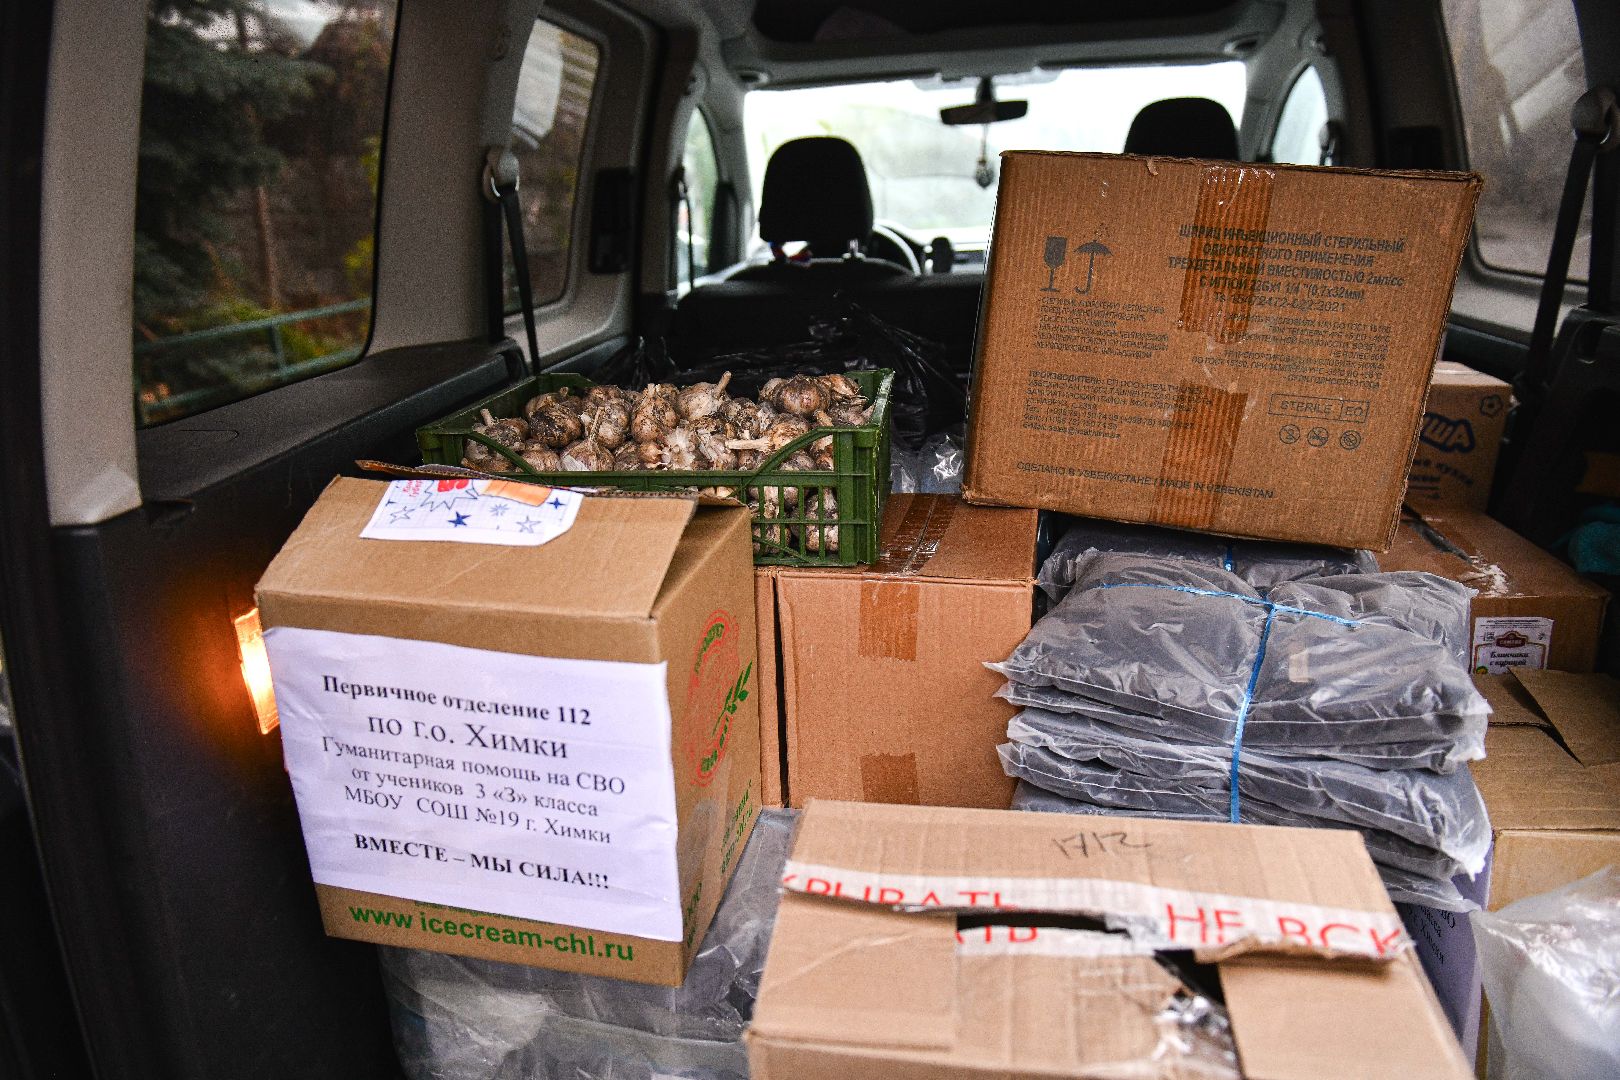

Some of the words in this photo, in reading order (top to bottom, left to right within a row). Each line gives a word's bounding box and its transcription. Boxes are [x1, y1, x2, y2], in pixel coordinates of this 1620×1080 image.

[1179, 222, 1221, 239] ШПРИЦ
[1222, 225, 1322, 247] ИНЪЕКЦИОННЫЙ
[1322, 232, 1405, 253] СТЕРИЛЬНЫЙ
[1202, 243, 1292, 260] ОДНОКРАТНОГО
[1294, 249, 1374, 267] ПРИМЕНЕНИЯ
[1209, 276, 1247, 291] ИГЛОЙ
[1265, 263, 1365, 284] ВМЕСТИМОСТЬЮ
[1279, 399, 1332, 413] STERILE
[1016, 461, 1065, 476] СДЕЛАНО
[1076, 468, 1152, 485] УЗБЕКИСТАНЕ
[1206, 482, 1274, 498] UZBEKISTAN
[323, 675, 437, 705] Первичное
[443, 695, 550, 720] отделение
[558, 705, 592, 726] 112
[323, 736, 455, 770] Гуманитарная
[462, 759, 540, 783] помощь
[547, 770, 569, 788] на
[576, 773, 624, 796] СВО
[352, 767, 368, 782] от
[376, 769, 464, 796] учеников
[476, 783, 485, 800] 3
[534, 793, 599, 817] класса
[345, 785, 402, 810] МБОУ
[417, 797, 468, 821] СОШ
[476, 806, 519, 828] №19
[526, 817, 537, 832] г.
[545, 817, 611, 844] Химки
[355, 833, 447, 862] ВМЕСТЕ
[470, 853, 512, 873] МЫ
[520, 860, 609, 890] СИЛА!!!
[349, 904, 413, 929] www
[420, 912, 634, 961] icecream-chl.ru
